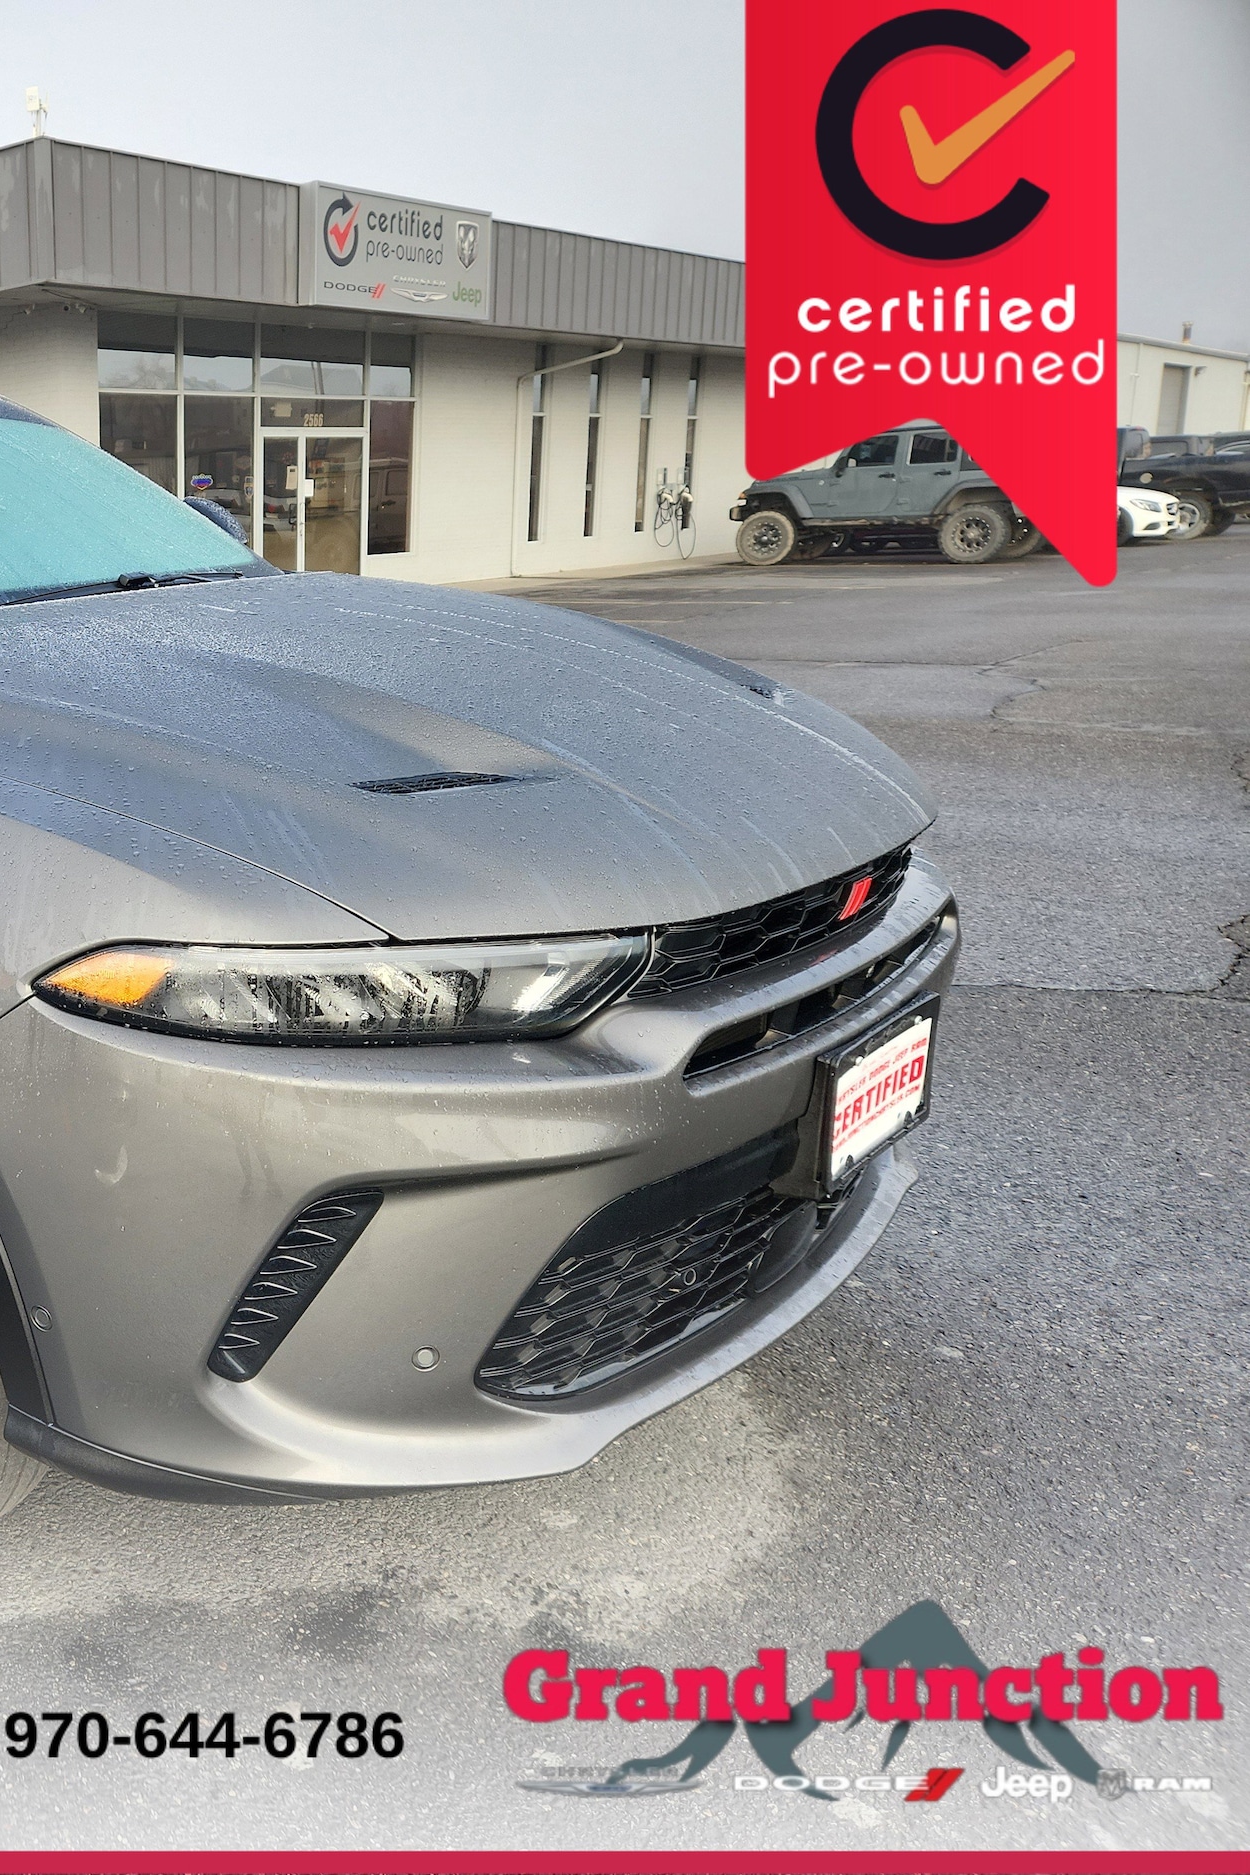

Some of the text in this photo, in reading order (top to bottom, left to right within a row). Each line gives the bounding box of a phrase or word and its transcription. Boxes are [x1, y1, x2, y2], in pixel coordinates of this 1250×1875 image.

[366, 208, 444, 242] certified
[365, 240, 444, 266] pre-owned
[323, 280, 379, 295] DODGE
[452, 281, 483, 308] Jeep
[303, 413, 325, 427] 2566
[833, 1055, 926, 1141] CERTIFIED
